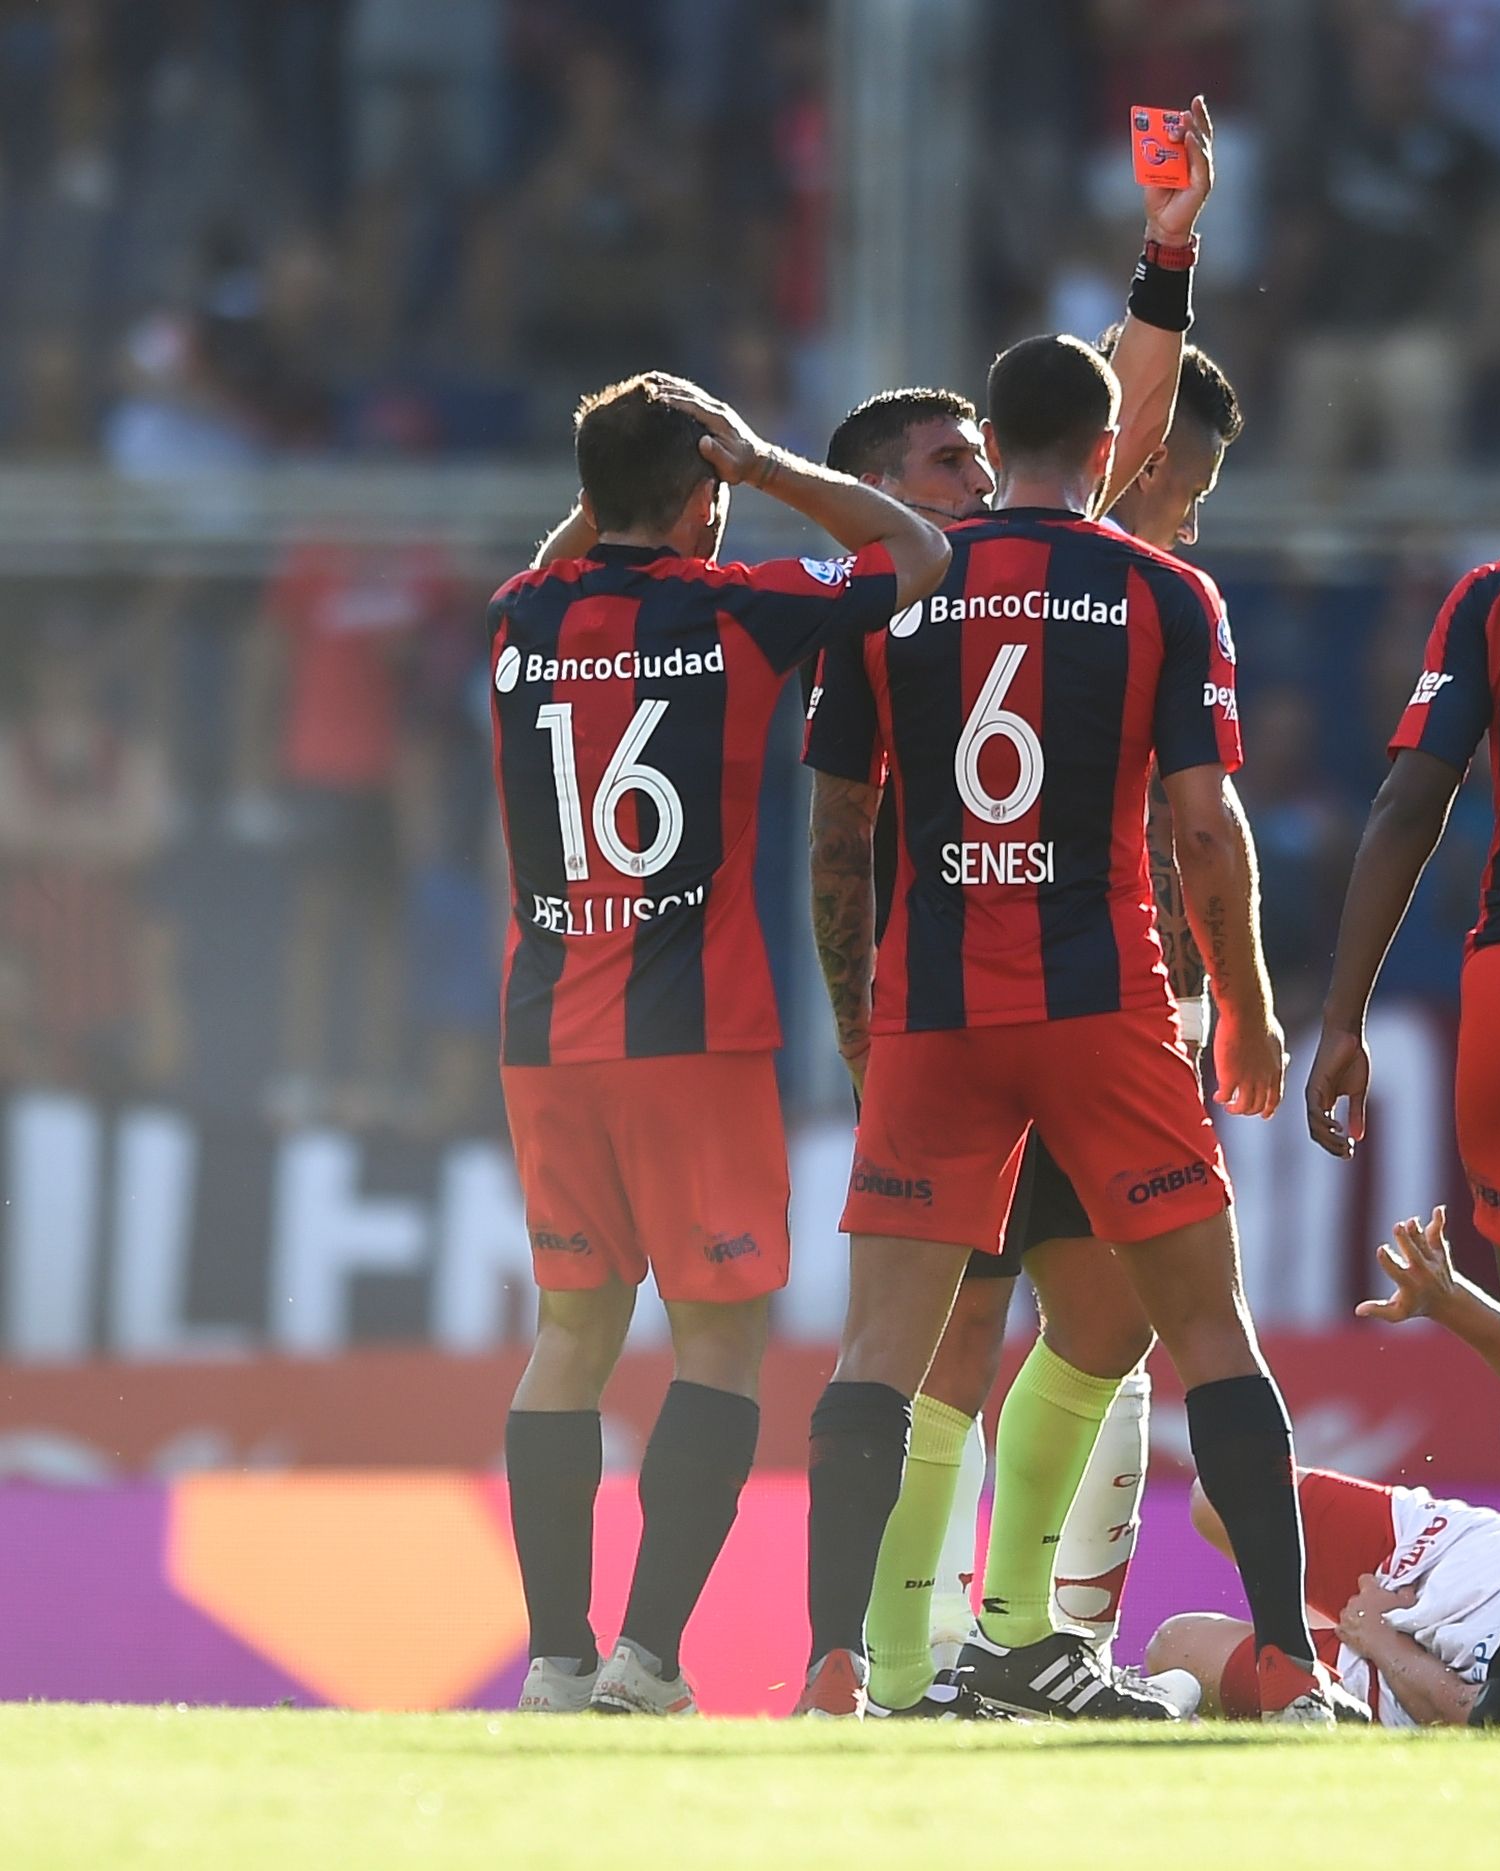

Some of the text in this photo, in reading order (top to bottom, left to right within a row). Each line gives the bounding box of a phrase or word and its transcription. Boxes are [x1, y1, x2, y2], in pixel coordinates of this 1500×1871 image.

[930, 591, 1129, 628] BancoCiudad
[524, 643, 725, 684] BancoCiudad
[953, 643, 1045, 825] 6
[534, 698, 685, 882] 16
[939, 840, 1056, 886] SENESI
[1128, 1161, 1209, 1206] ORBIS
